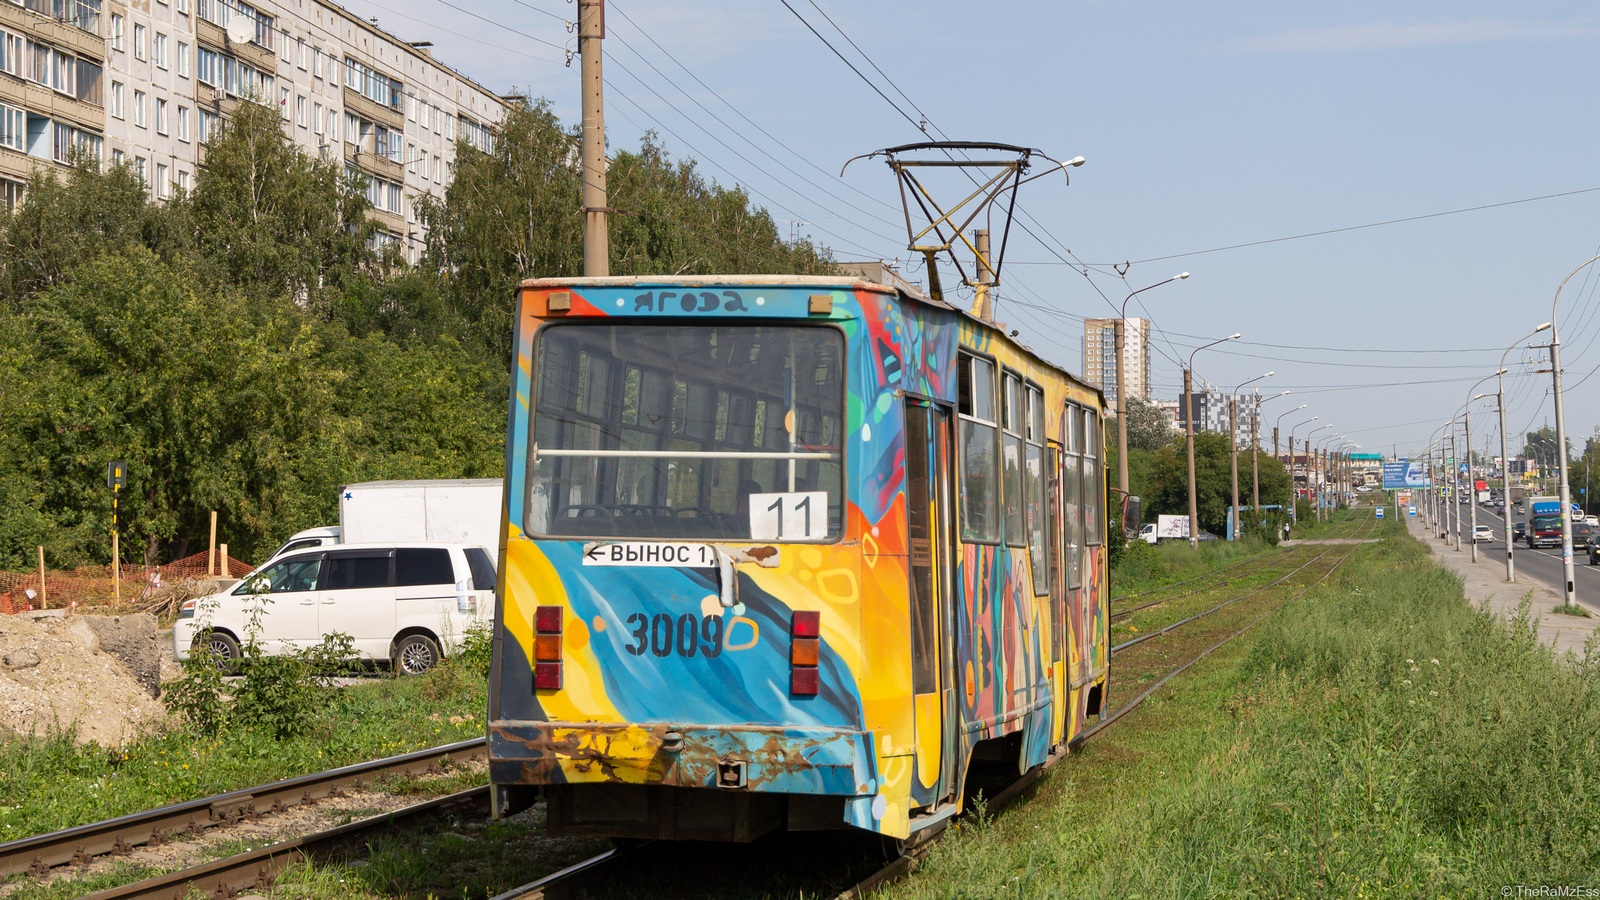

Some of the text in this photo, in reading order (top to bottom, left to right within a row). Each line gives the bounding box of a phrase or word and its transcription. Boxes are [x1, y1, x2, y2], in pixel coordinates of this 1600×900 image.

[767, 495, 811, 537] 11
[610, 544, 690, 563] ВЫНОС
[625, 612, 724, 658] 3009
